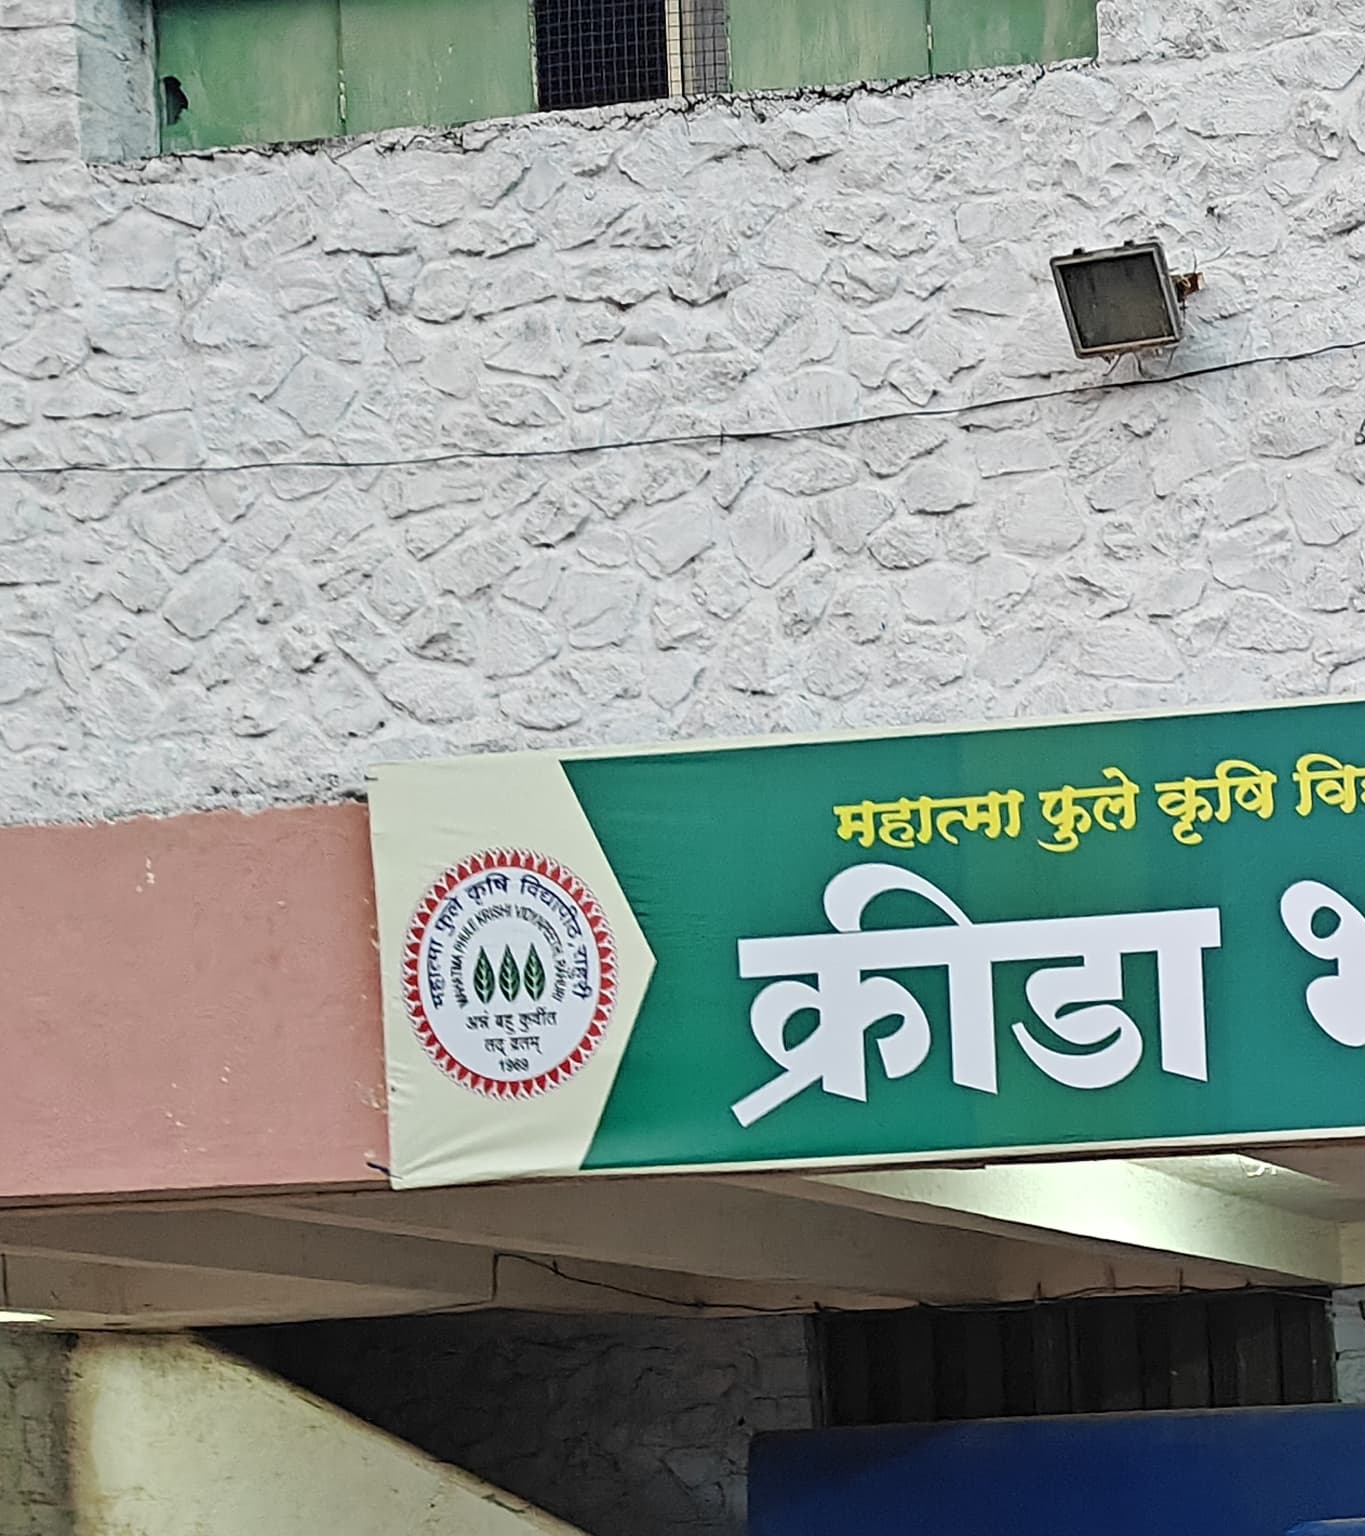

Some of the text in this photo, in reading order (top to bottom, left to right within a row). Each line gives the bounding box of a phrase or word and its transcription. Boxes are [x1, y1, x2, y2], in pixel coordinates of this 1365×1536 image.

[833, 790, 1025, 848] महात्मा
[1037, 767, 1140, 852] फुले
[1154, 759, 1277, 846] कृषि
[730, 863, 1221, 1127] क्रीडा
[499, 1057, 530, 1073] 1969
